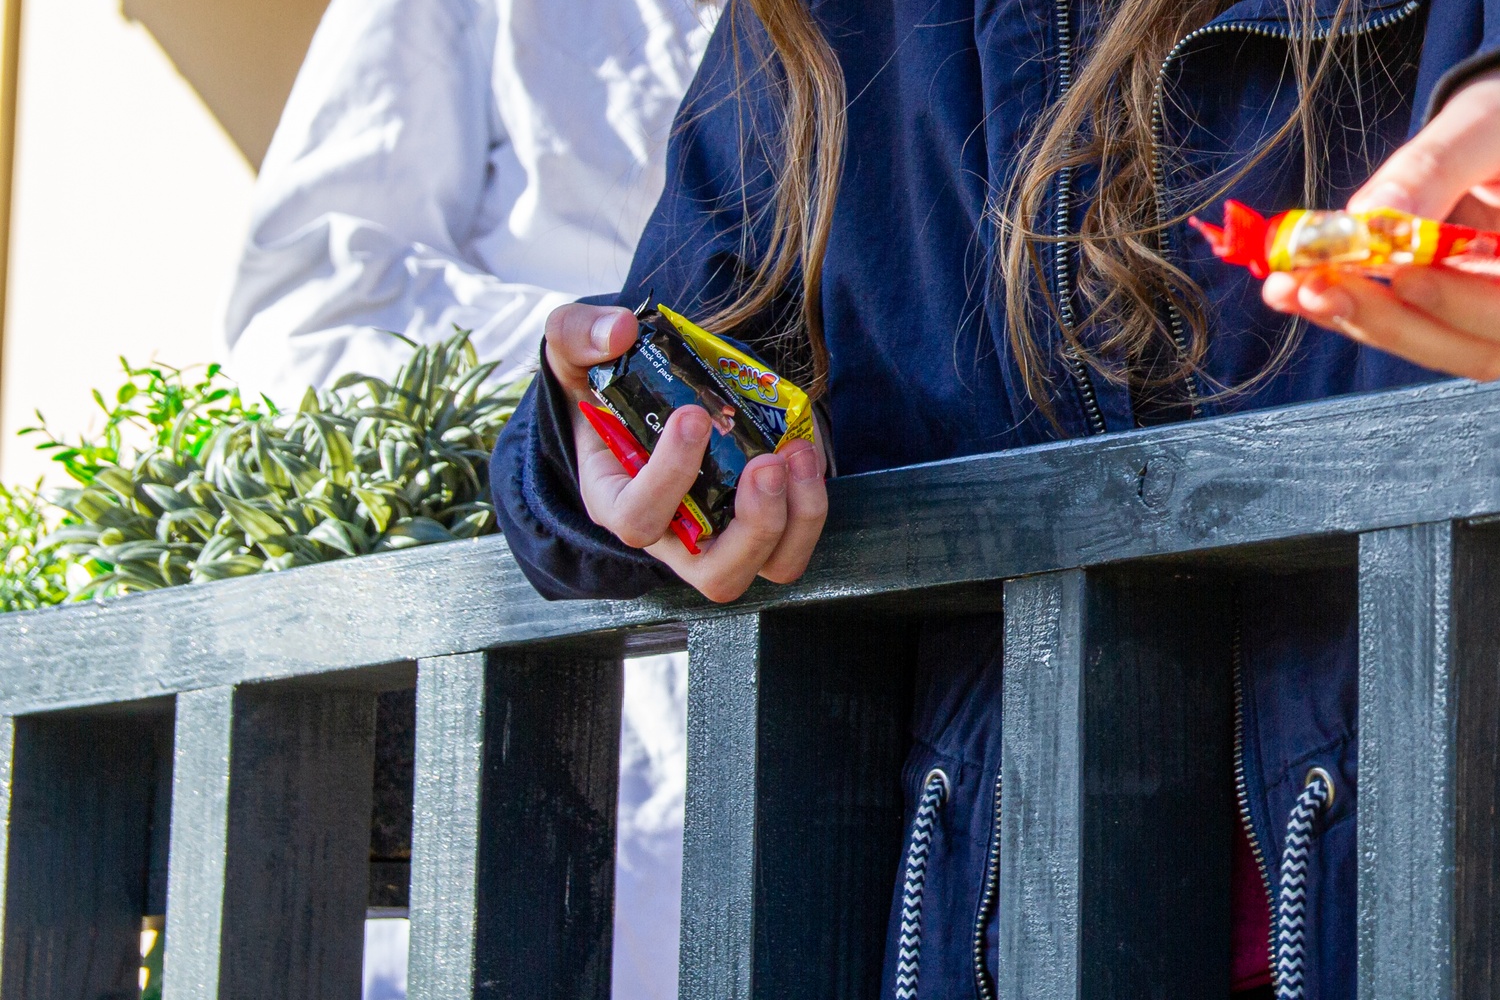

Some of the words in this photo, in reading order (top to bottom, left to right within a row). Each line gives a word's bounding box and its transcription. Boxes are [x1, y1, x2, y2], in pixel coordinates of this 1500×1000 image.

[639, 346, 654, 362] back
[652, 361, 662, 369] of
[657, 364, 674, 383] pack
[648, 343, 669, 366] Before:
[707, 370, 725, 388] chewy
